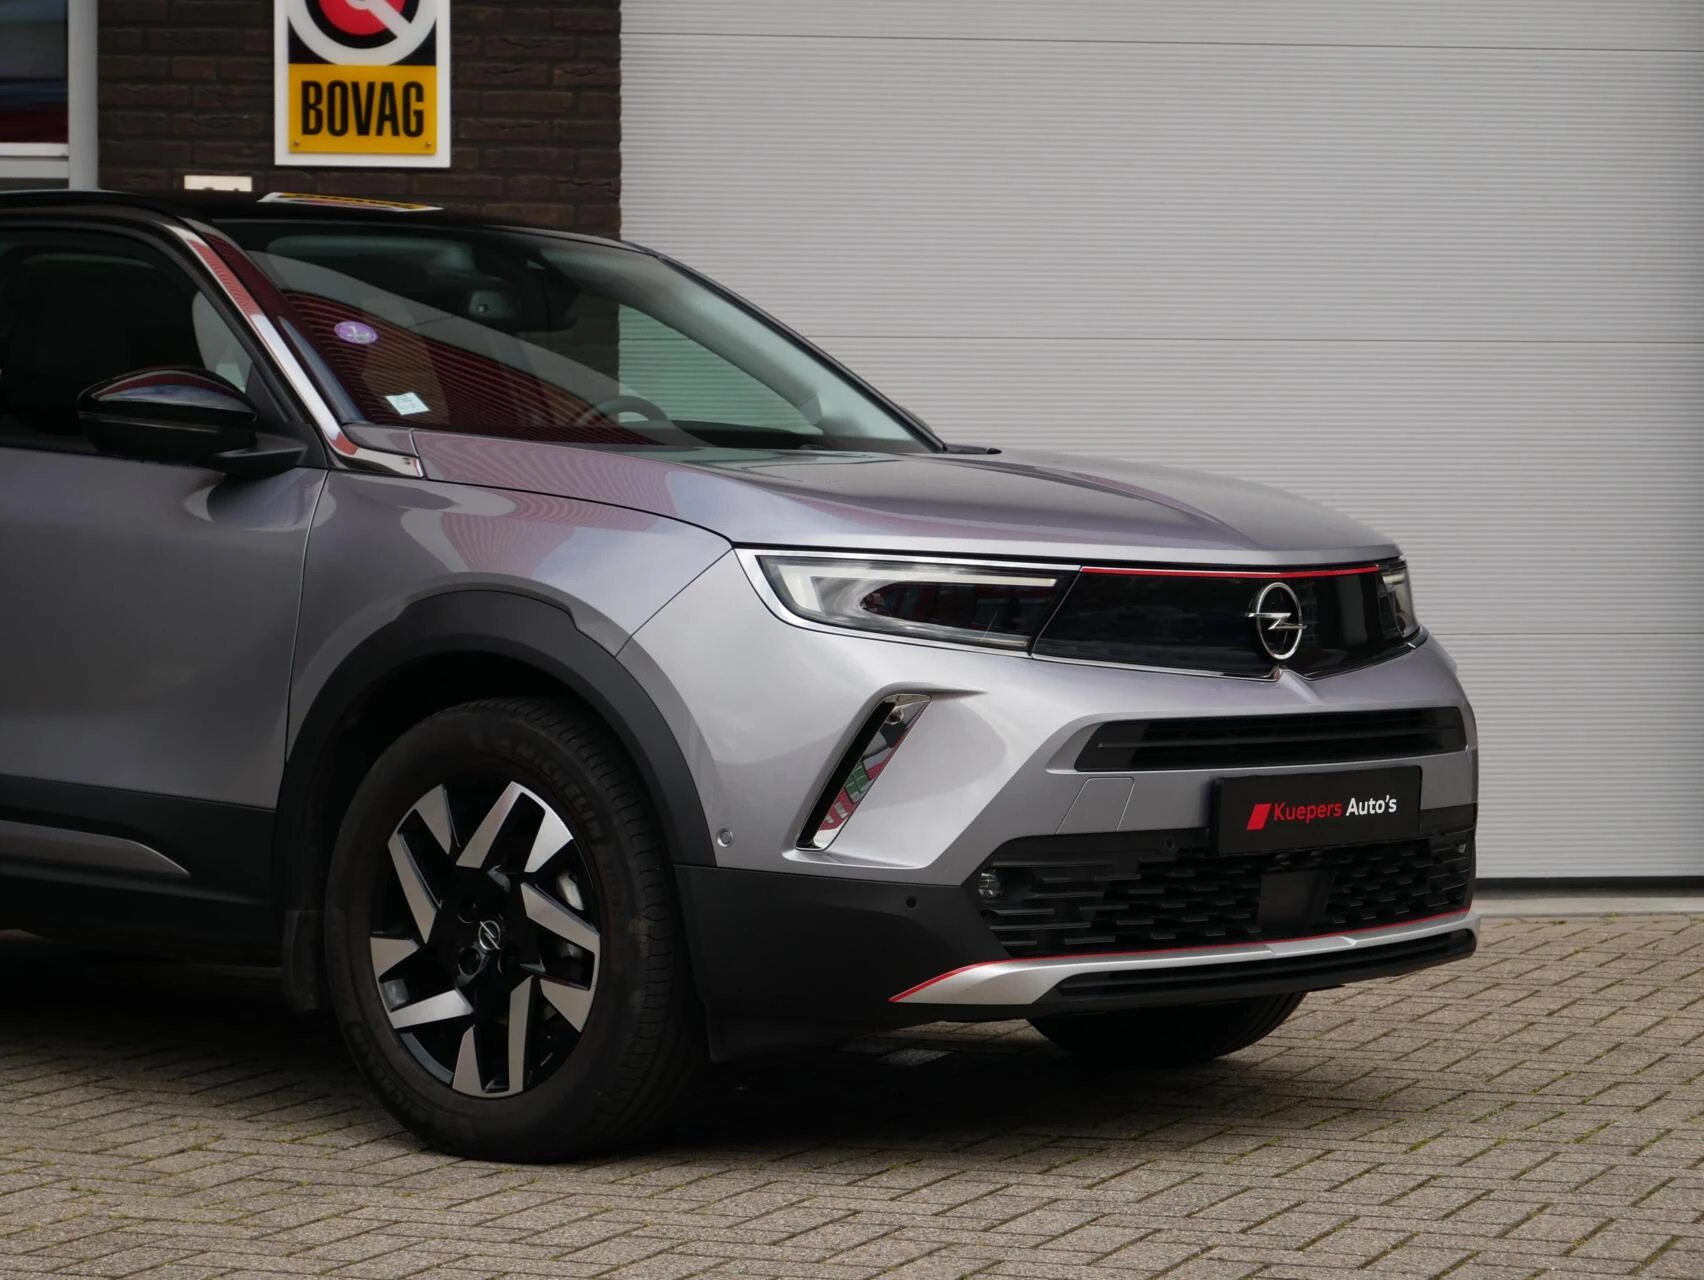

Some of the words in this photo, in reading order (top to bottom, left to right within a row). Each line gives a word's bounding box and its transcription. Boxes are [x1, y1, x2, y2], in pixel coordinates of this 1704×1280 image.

[301, 80, 424, 138] BOVAG
[514, 741, 605, 843] MICHELIN
[1273, 801, 1342, 824] Kuepers
